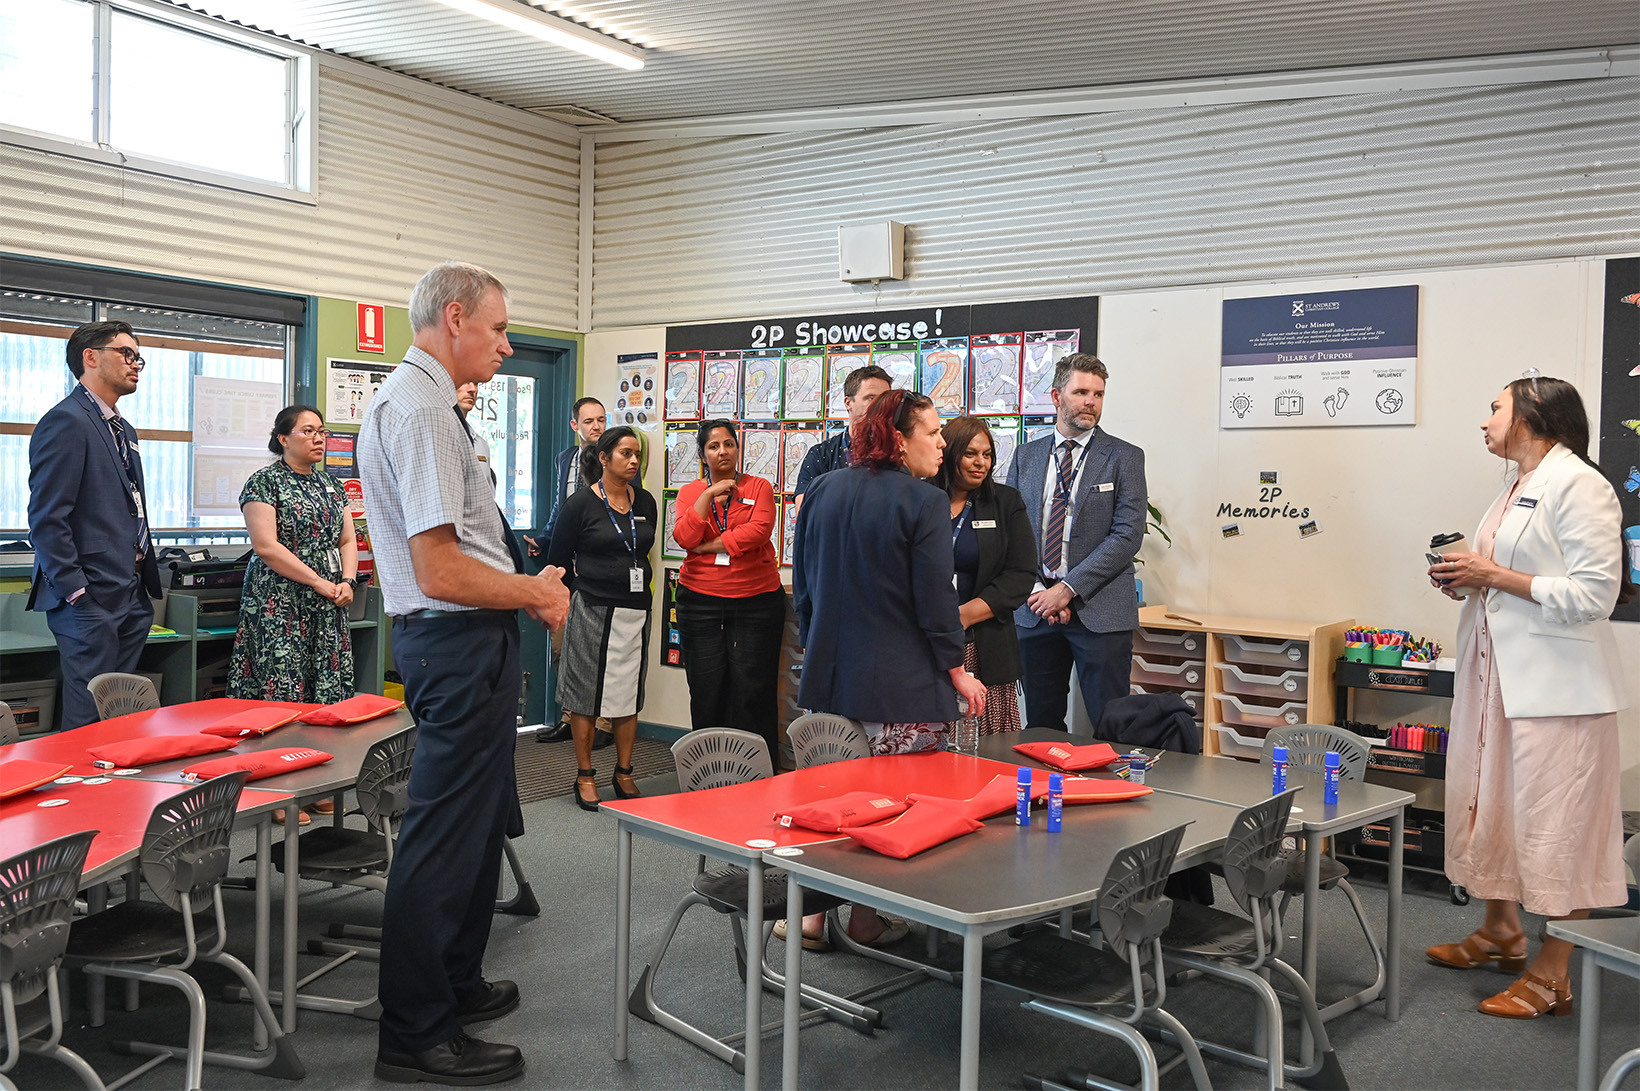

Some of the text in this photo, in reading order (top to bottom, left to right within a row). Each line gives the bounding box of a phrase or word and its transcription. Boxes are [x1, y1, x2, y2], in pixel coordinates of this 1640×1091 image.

[751, 324, 784, 349] 2P
[1318, 352, 1353, 360] PURPOSE
[1259, 487, 1282, 502] 2P
[1216, 502, 1310, 518] Memories
